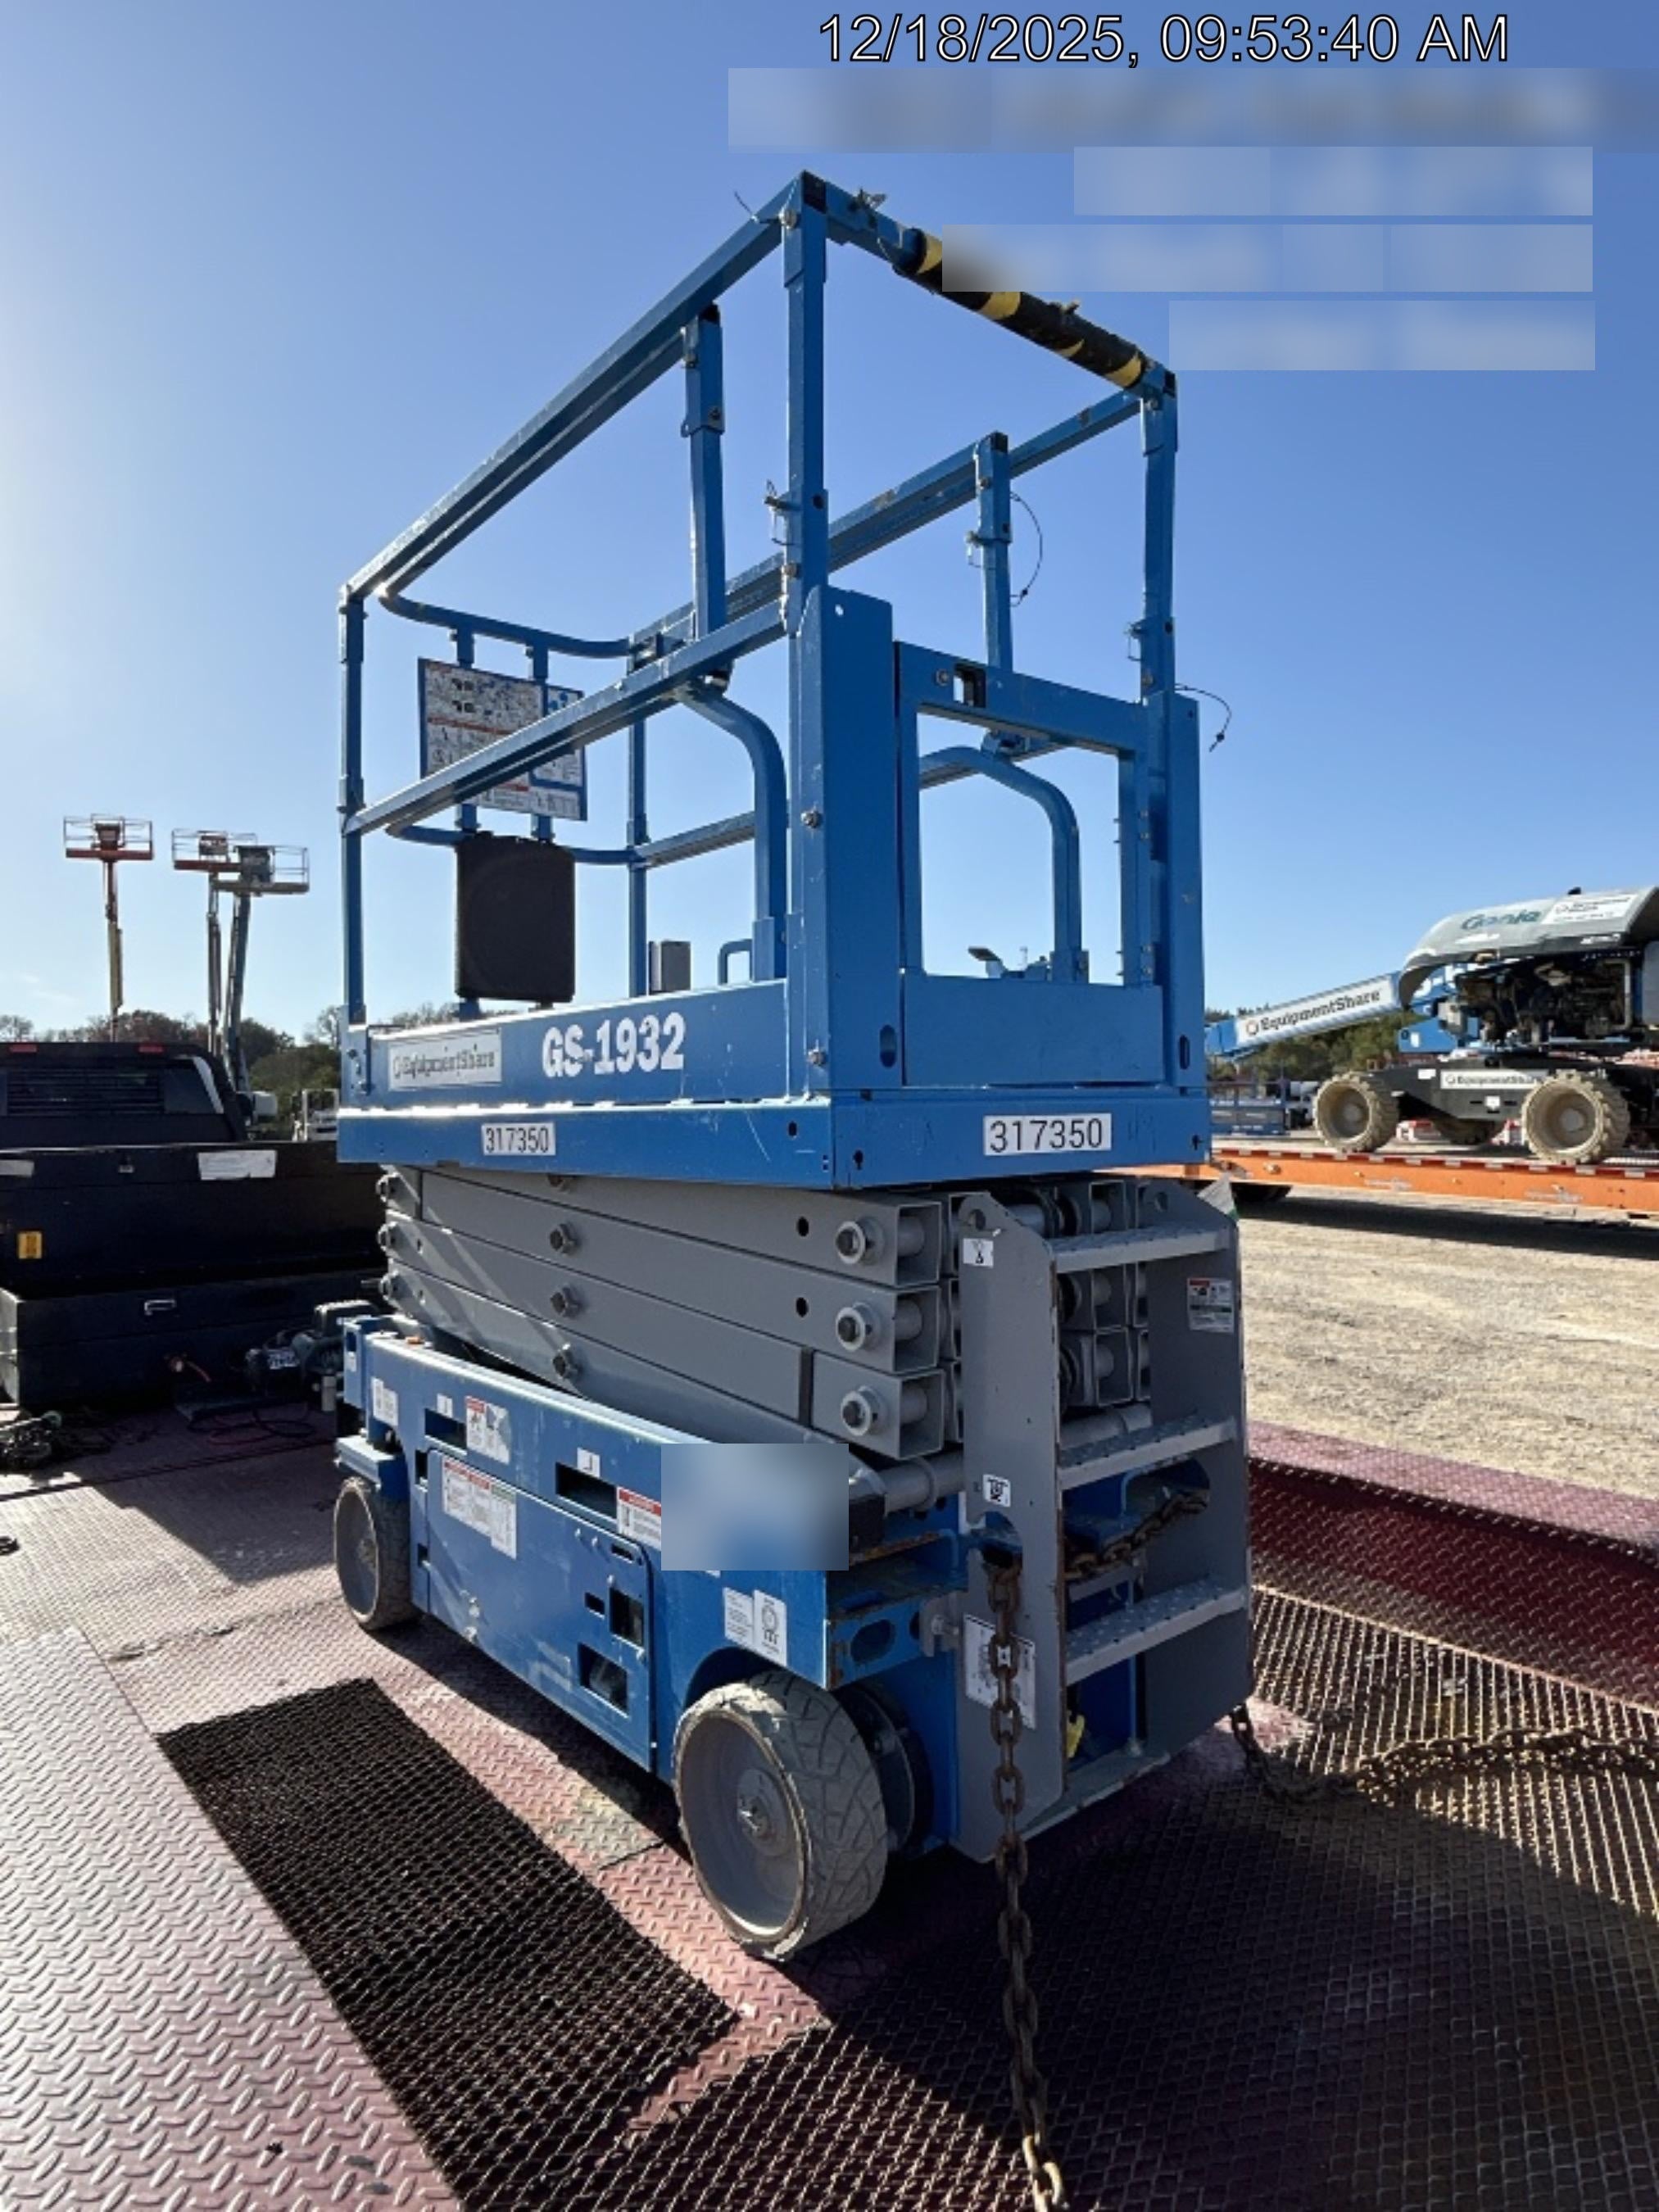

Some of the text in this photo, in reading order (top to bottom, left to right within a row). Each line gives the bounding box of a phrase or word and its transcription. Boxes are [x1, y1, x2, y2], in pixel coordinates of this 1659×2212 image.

[1460, 909, 1541, 930] Genie
[1260, 990, 1381, 1031] EquipmentShare
[542, 1012, 685, 1077] GS-1932
[485, 1126, 549, 1154] 317350
[990, 1117, 1103, 1153] 317350
